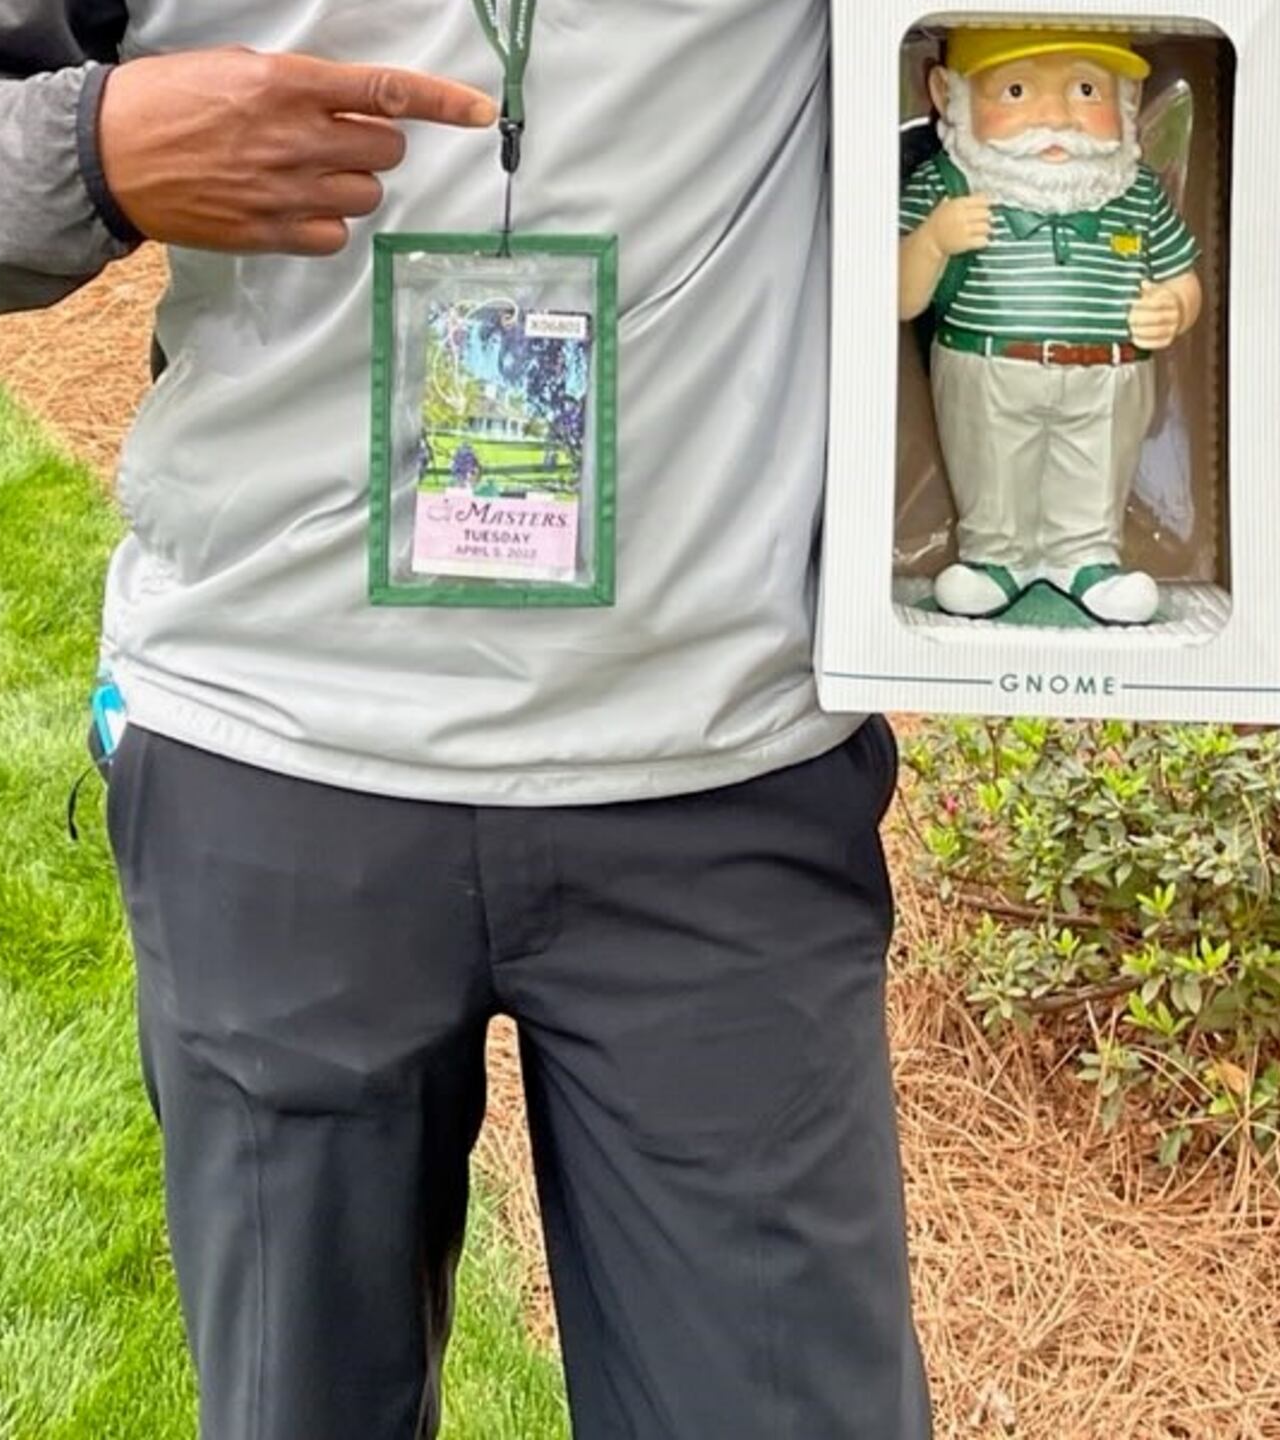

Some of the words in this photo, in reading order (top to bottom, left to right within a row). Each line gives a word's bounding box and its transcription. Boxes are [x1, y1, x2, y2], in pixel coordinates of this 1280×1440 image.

[455, 501, 568, 528] MASTERS
[464, 529, 532, 544] TUESDAY
[999, 673, 1116, 696] GNOME
